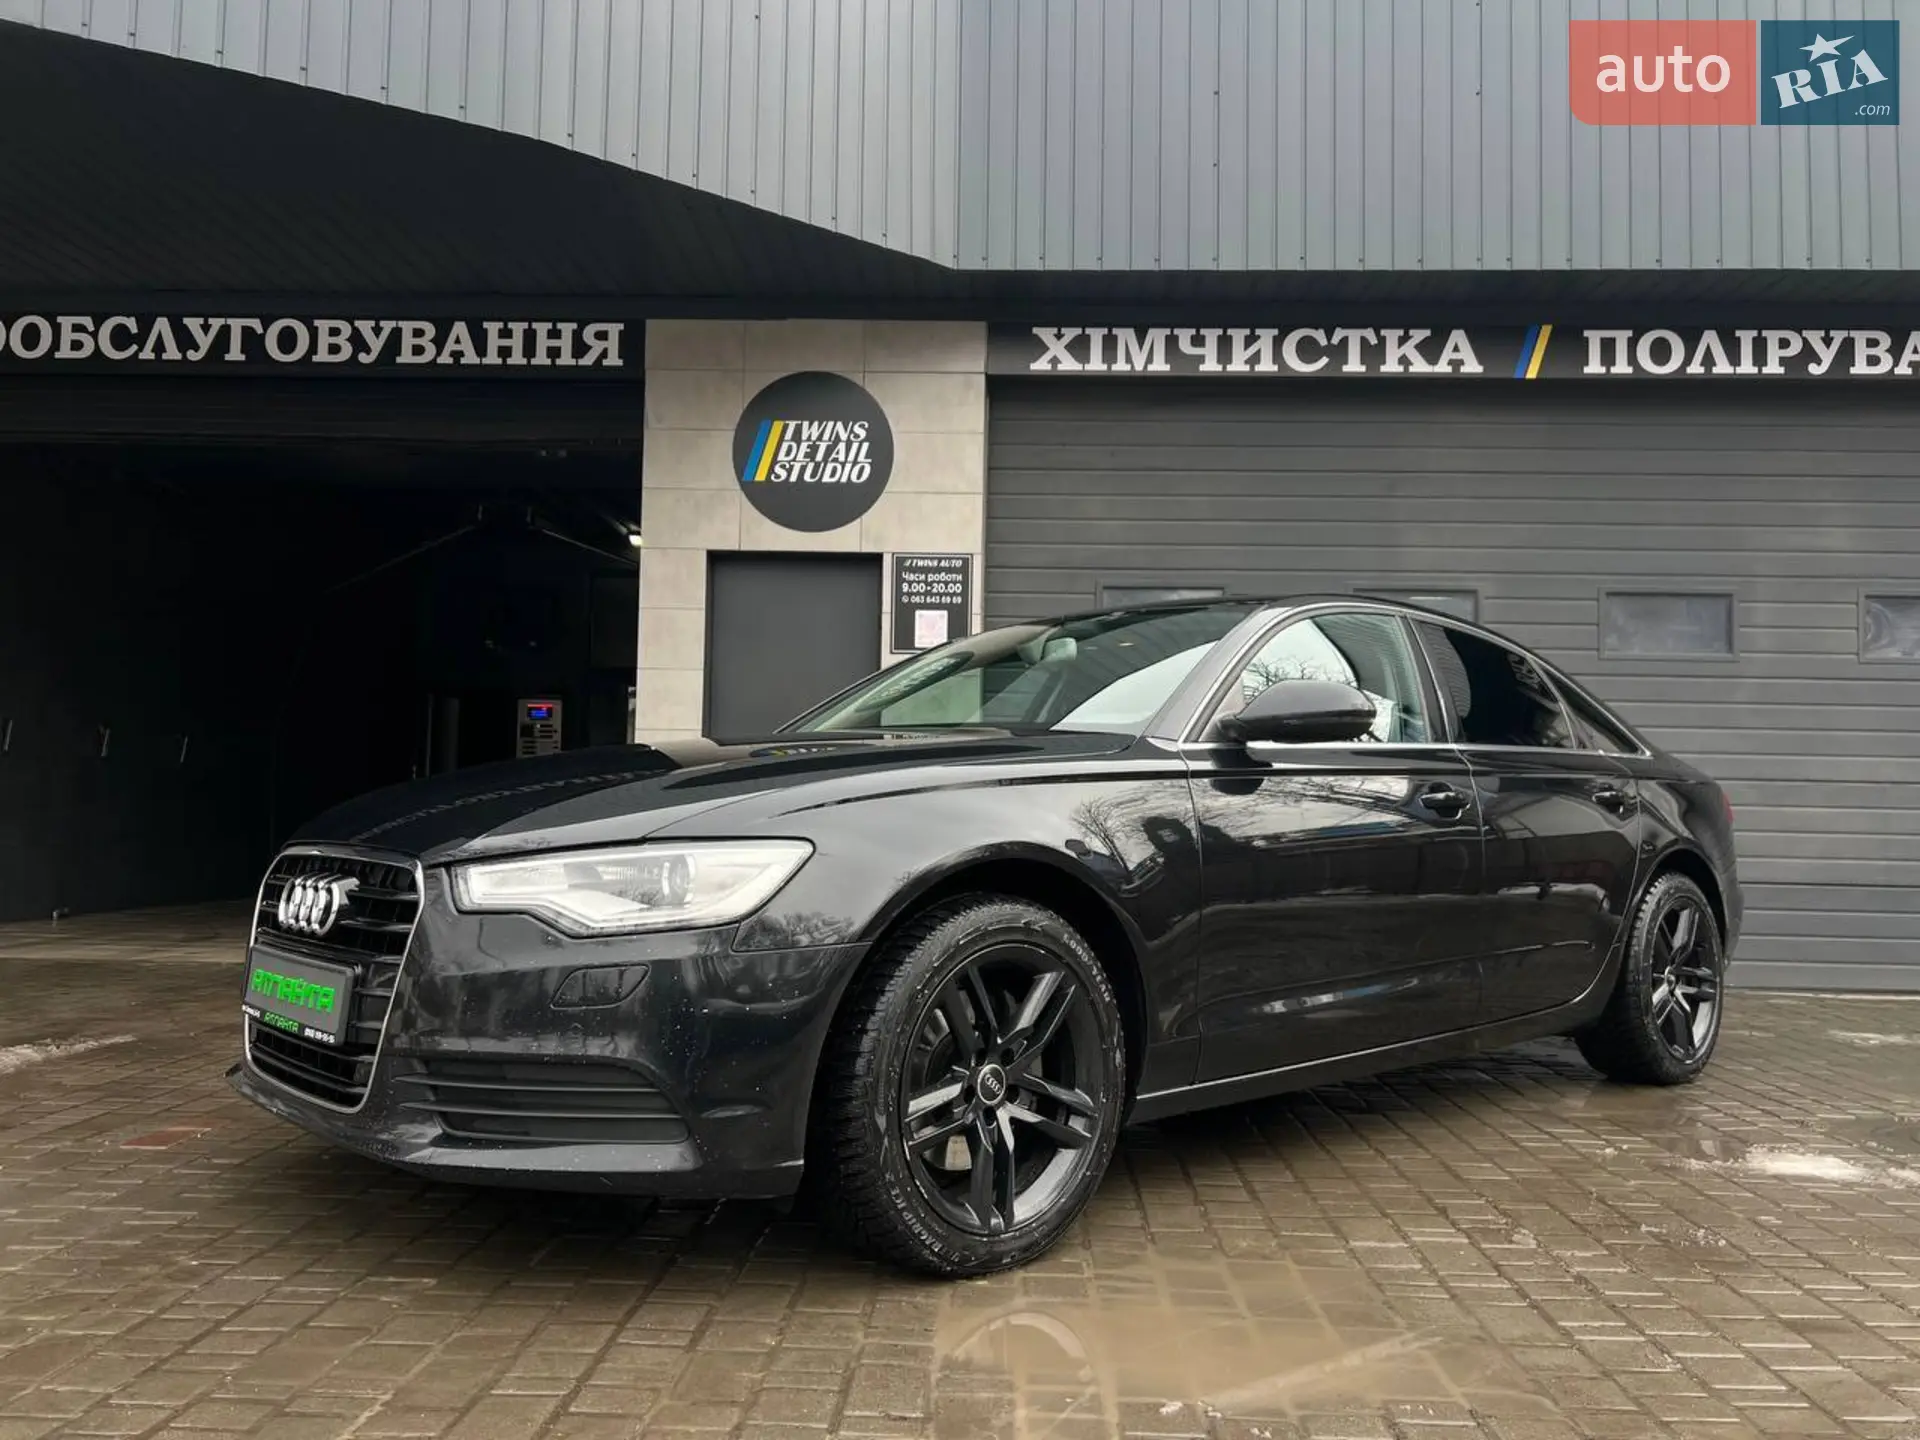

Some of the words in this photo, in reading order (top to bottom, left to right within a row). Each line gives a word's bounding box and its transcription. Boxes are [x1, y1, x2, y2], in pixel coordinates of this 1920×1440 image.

[0, 314, 625, 366] ОБСЛУГОВУВАННЯ
[1030, 326, 1484, 373] ХІМЧИСТКА
[783, 420, 869, 442] TWINS
[776, 441, 872, 462] DETAIL
[770, 461, 871, 483] STUDIO
[912, 559, 938, 567] TWINS
[939, 559, 962, 567] AUTO
[902, 571, 926, 581] Часи
[927, 572, 962, 582] роботи
